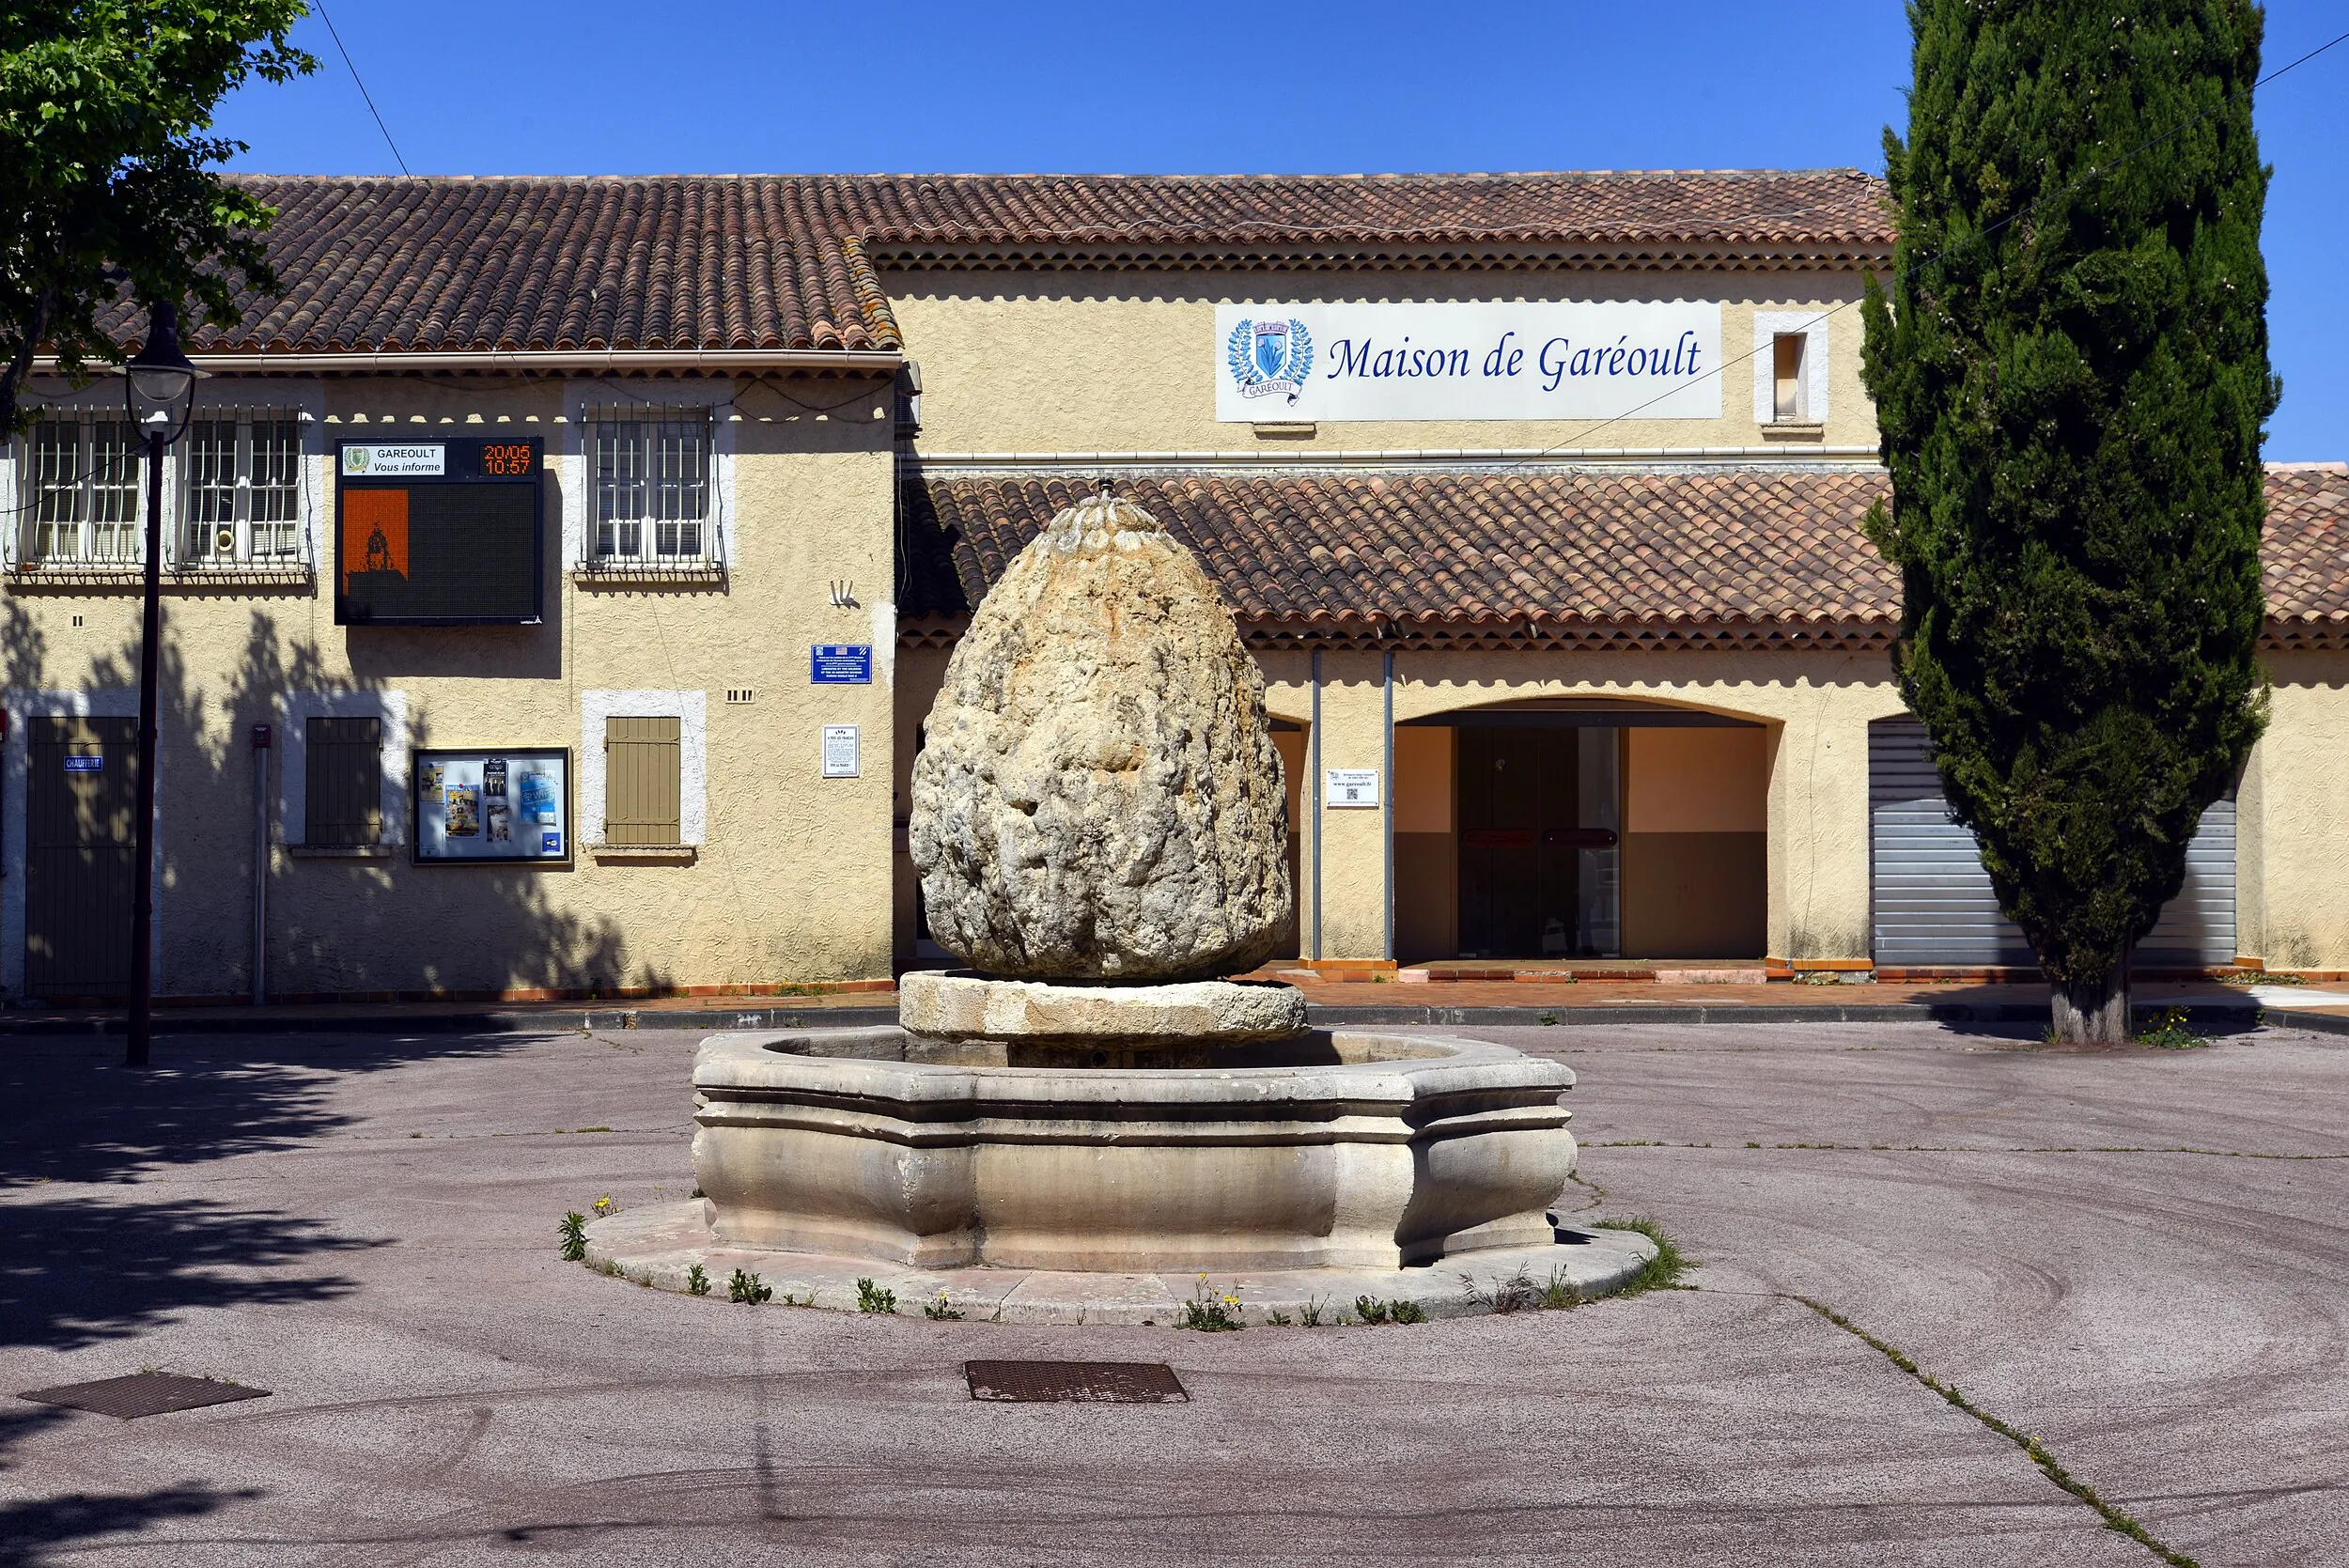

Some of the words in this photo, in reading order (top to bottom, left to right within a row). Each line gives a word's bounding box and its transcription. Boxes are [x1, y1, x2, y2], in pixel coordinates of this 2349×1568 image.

[1327, 336, 1470, 379] Maison
[1483, 331, 1524, 377] de
[1539, 330, 1702, 392] Garéoult
[377, 448, 437, 458] GAREOULT
[484, 445, 530, 459] 20/05
[374, 462, 399, 472] Vous
[401, 462, 441, 472] informe
[486, 459, 531, 474] 10:57
[66, 758, 100, 768] CHAUFFERIE
